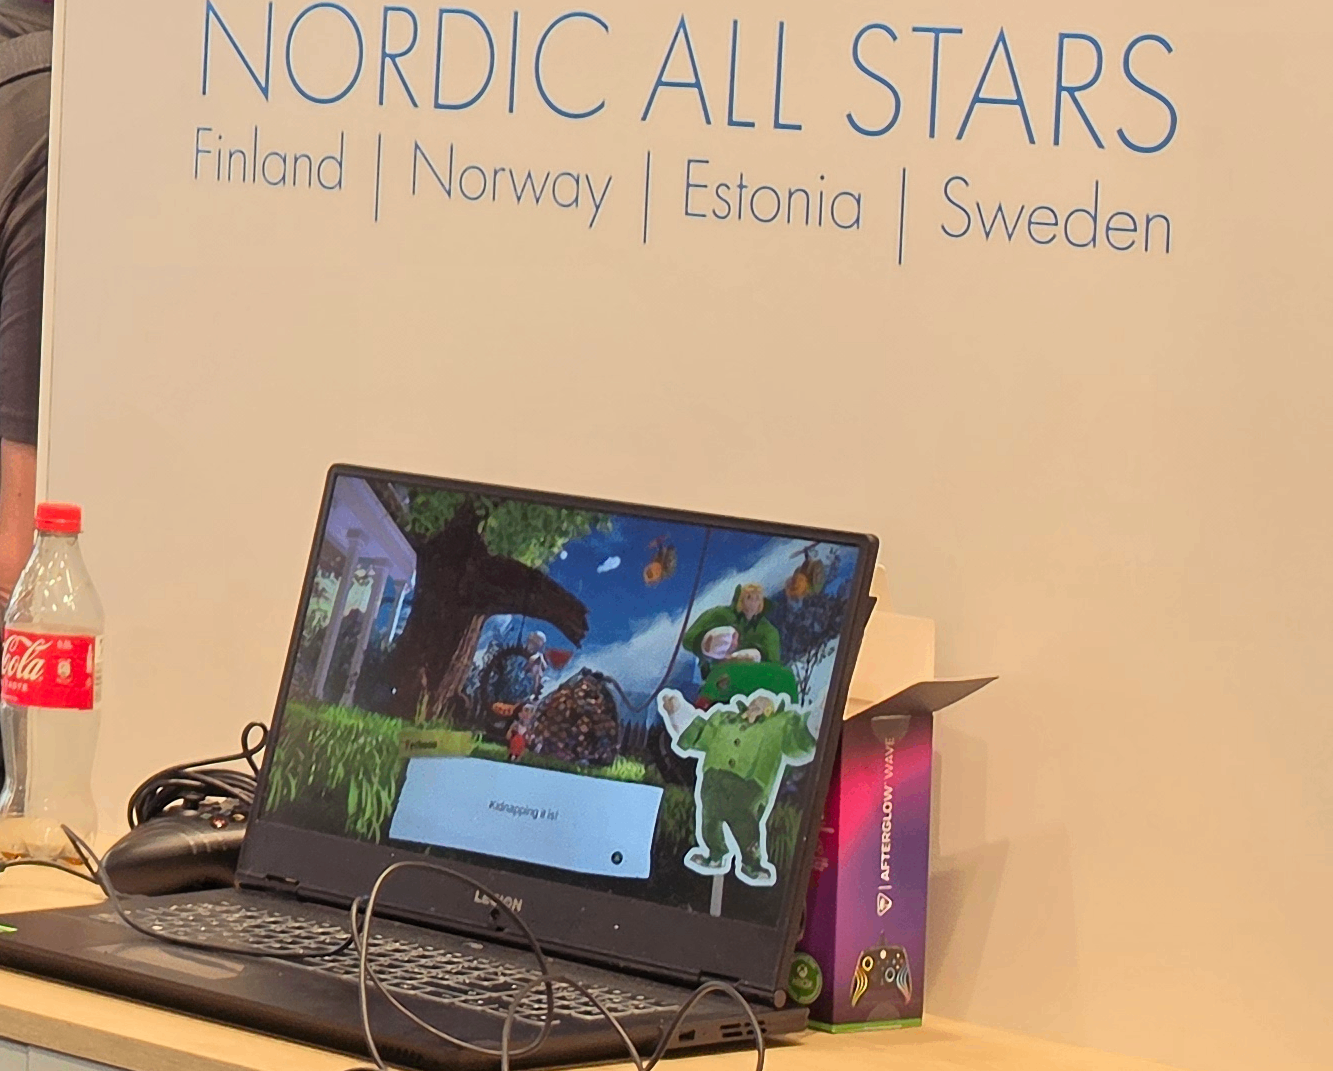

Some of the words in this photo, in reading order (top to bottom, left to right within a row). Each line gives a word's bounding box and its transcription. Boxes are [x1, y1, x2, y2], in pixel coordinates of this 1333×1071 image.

[641, 14, 803, 132] ALL
[845, 22, 1179, 155] STARS
[193, 126, 345, 193] Finland
[411, 140, 613, 229] Norway
[683, 159, 863, 232] Estonia
[939, 175, 1172, 255] Sweden
[883, 735, 896, 780] WAVE
[488, 799, 539, 821] Kidnapping
[880, 782, 894, 882] AFTERGLOW
